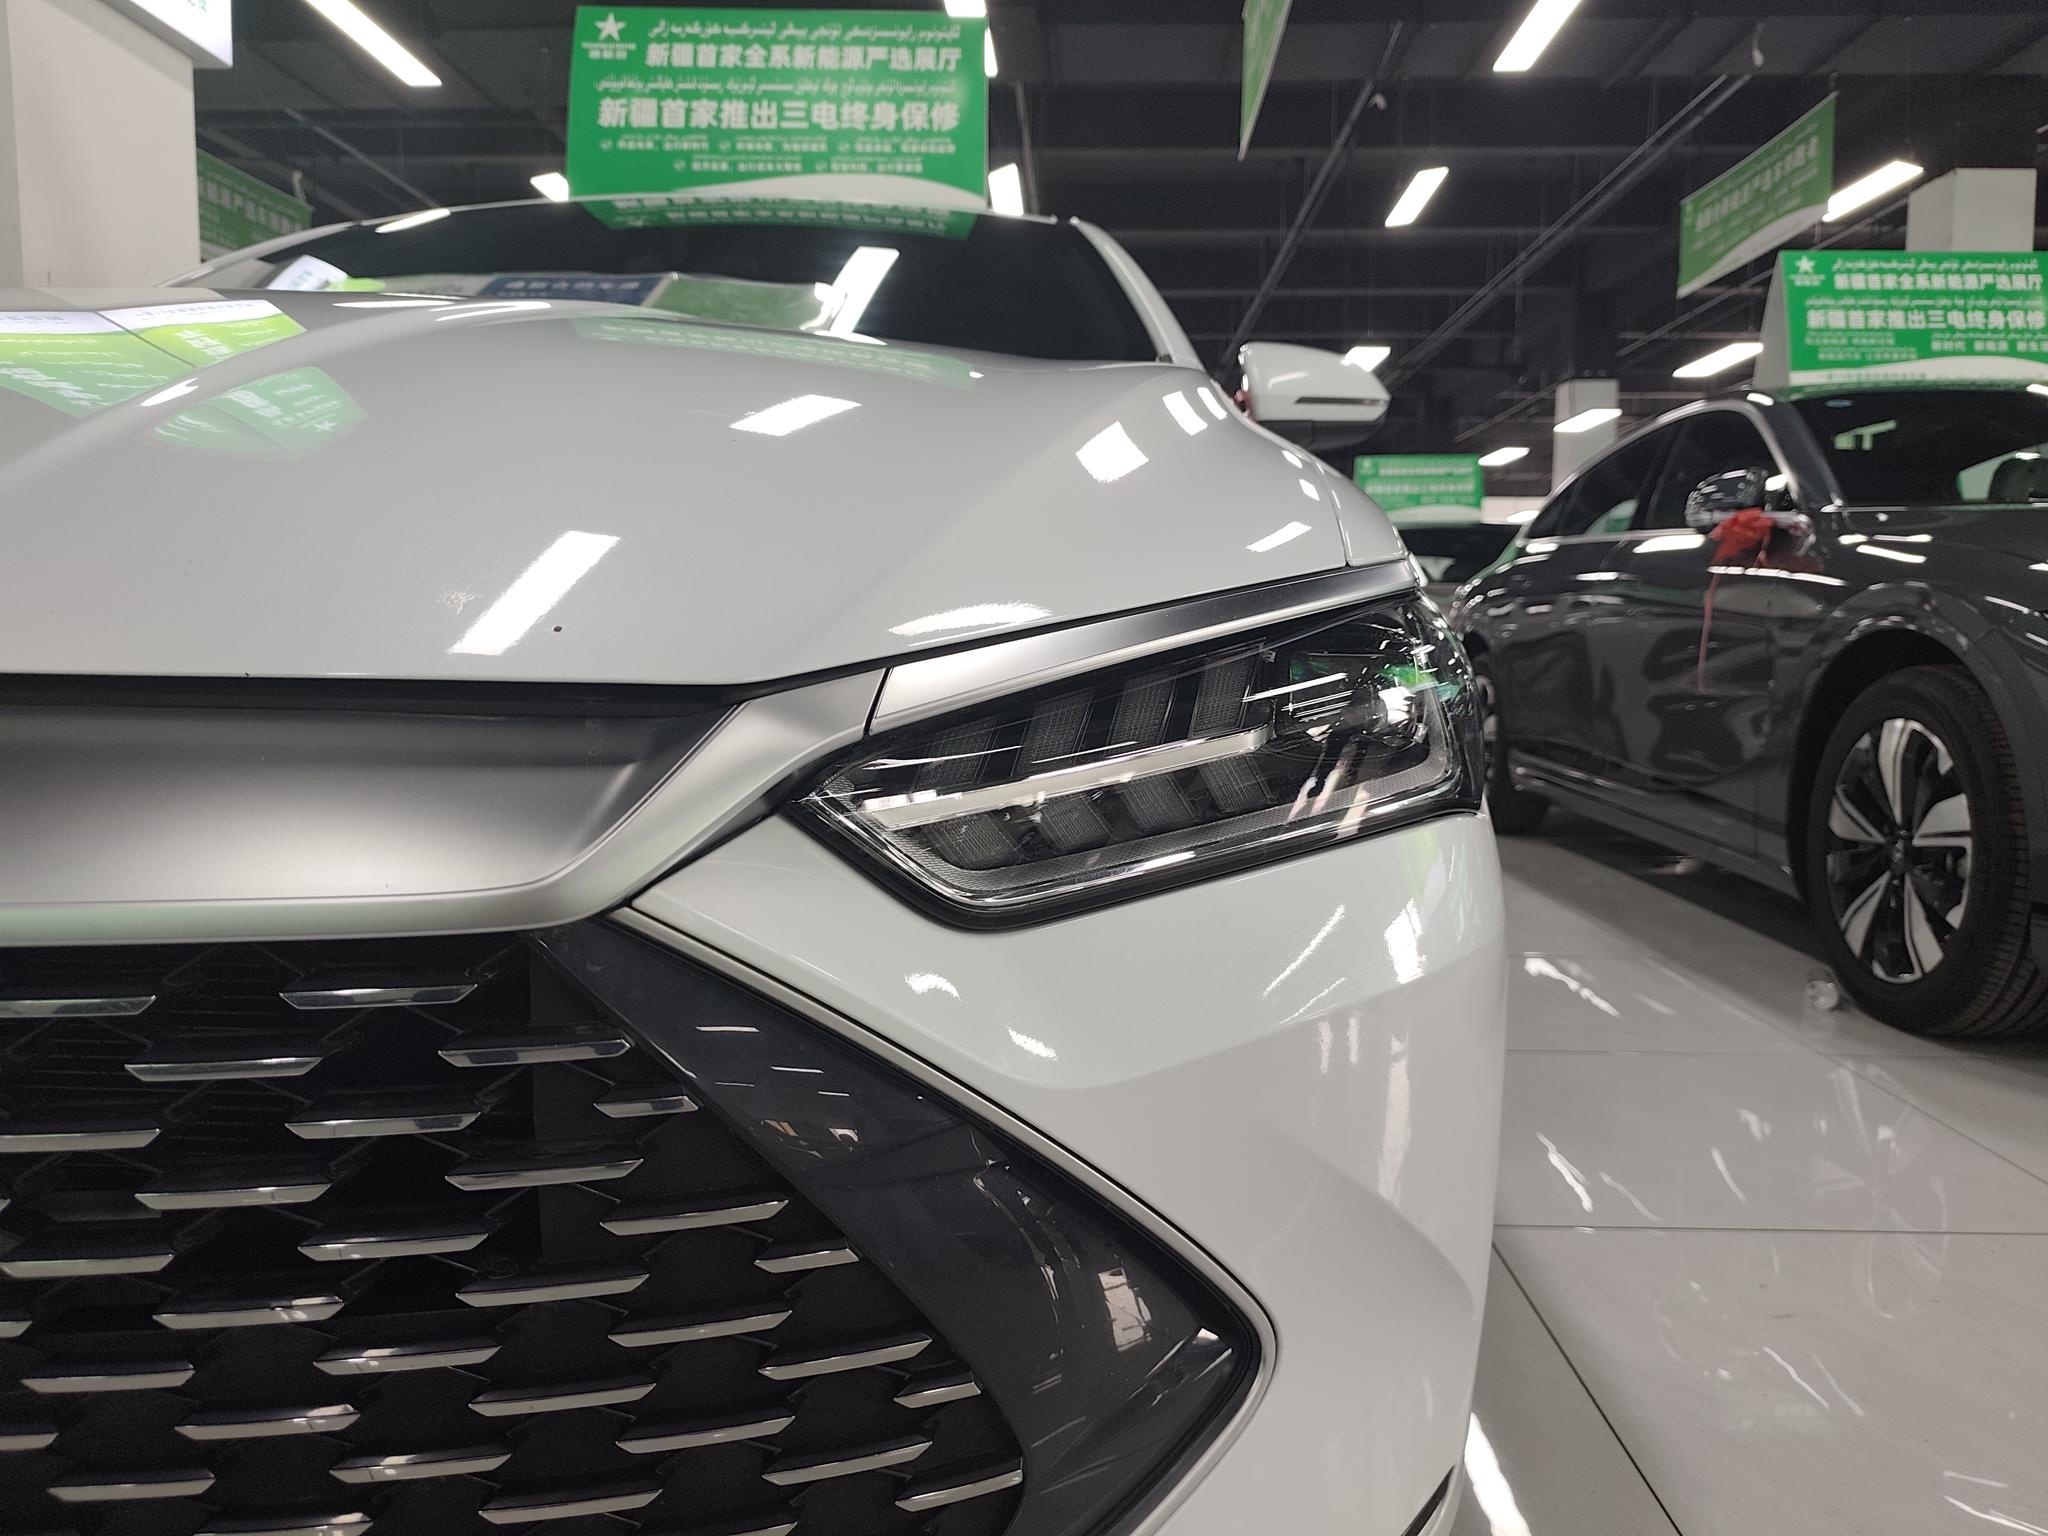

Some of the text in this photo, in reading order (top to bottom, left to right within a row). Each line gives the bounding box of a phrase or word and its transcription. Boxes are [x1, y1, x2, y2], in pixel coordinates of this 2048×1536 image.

[645, 42, 962, 71] 新疆首家全系新能源严选展厅
[597, 97, 960, 131] 新疆首家推出三电终身保修
[1833, 273, 2043, 291] 新疆首家全系新能源严选展厅
[1806, 309, 2046, 330] 新疆首家推出三电终身保修
